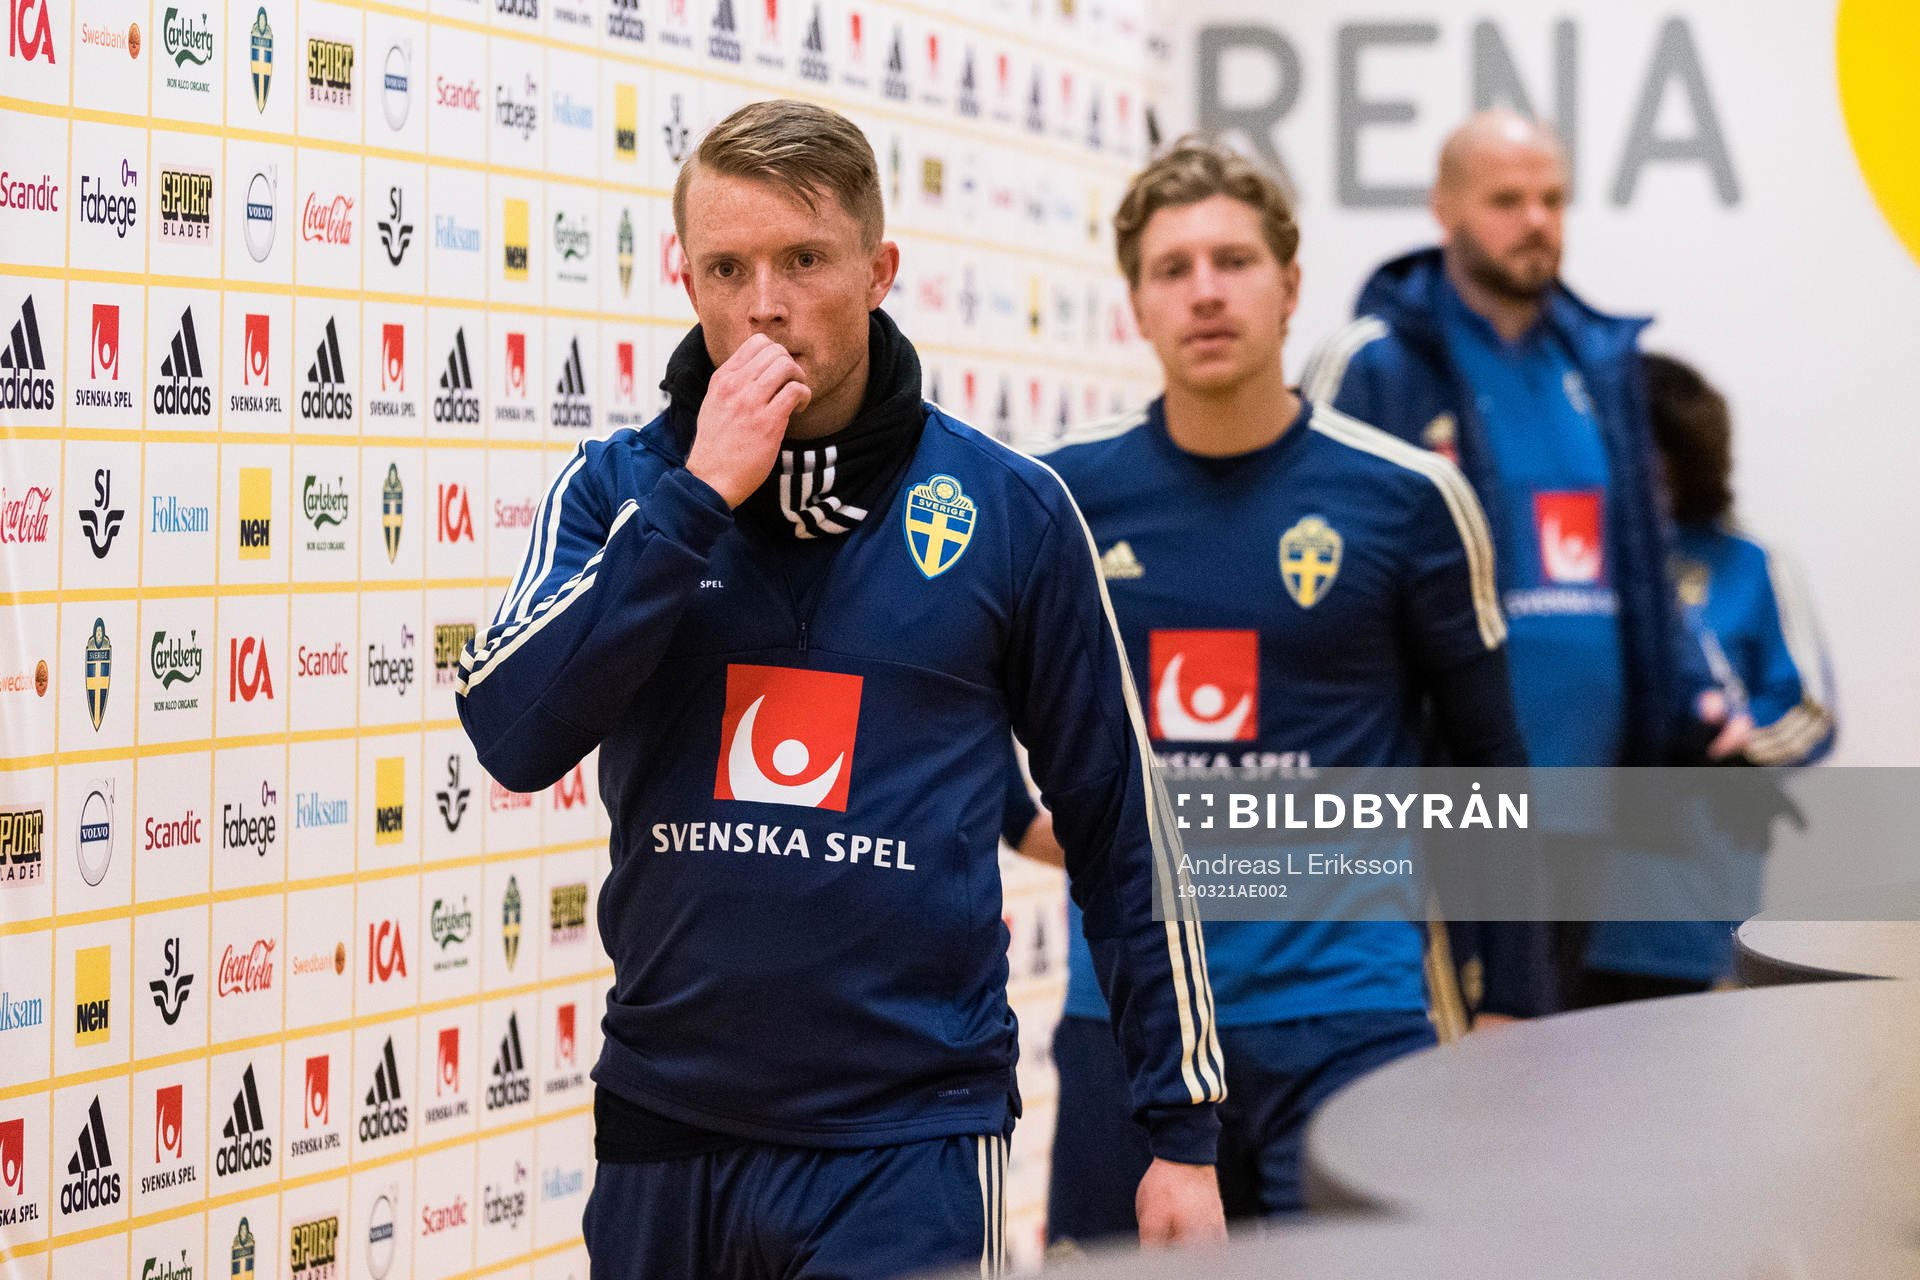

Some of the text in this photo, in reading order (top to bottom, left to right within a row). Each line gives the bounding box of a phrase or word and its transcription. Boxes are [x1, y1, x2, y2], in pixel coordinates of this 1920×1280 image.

[10, 0, 56, 64] ICA
[82, 24, 126, 49] Swedbank
[164, 7, 213, 68] Carlsberg
[308, 38, 353, 89] SPORT
[190, 81, 210, 93] ORGANIC
[436, 75, 480, 111] Scandic
[0, 171, 58, 212] Scandic
[81, 176, 136, 238] Fabege
[161, 171, 212, 224] SPORT
[390, 187, 402, 222] SJ
[163, 223, 210, 239] BLADET
[248, 205, 273, 219] VOLVO
[435, 214, 480, 251] Folksam
[76, 389, 132, 408] SVENSKA SPEL
[154, 376, 211, 415] adidas
[231, 395, 282, 412] SVENSKA SPEL
[301, 382, 352, 420] adidas
[434, 388, 479, 423] adidas
[95, 469, 110, 510] SJ
[304, 475, 349, 531] Carlsberg
[918, 498, 966, 518] SVERIGE
[152, 496, 208, 533] Folksam
[438, 483, 474, 543] ICA
[700, 580, 724, 589] SPEL
[151, 630, 202, 690] Carlsberg
[230, 636, 273, 702] ICA
[298, 643, 348, 677] Scandic
[368, 645, 414, 696] Fabege
[154, 699, 198, 711] NON ALCO ORGANIC
[145, 811, 201, 850] Scandic
[223, 803, 276, 857] Fabege
[296, 793, 348, 829] Folksam
[0, 809, 43, 865] PORT
[81, 826, 108, 840] VOLVO
[651, 821, 916, 871] SVENSKA SPEL
[0, 863, 41, 881] ADET
[164, 938, 180, 978] SJ
[368, 918, 407, 984] ICA
[0, 992, 42, 1031] lksam
[359, 1100, 408, 1143] adidas
[216, 1132, 272, 1177] adidas
[292, 1134, 340, 1157] SVENSKA SPEL
[61, 1168, 120, 1215] adidas
[142, 1166, 196, 1194] SVENSKA SPEL
[19, 1203, 39, 1223] SPEL
[422, 1195, 468, 1236] Scandic
[291, 1216, 337, 1273] SPORT
